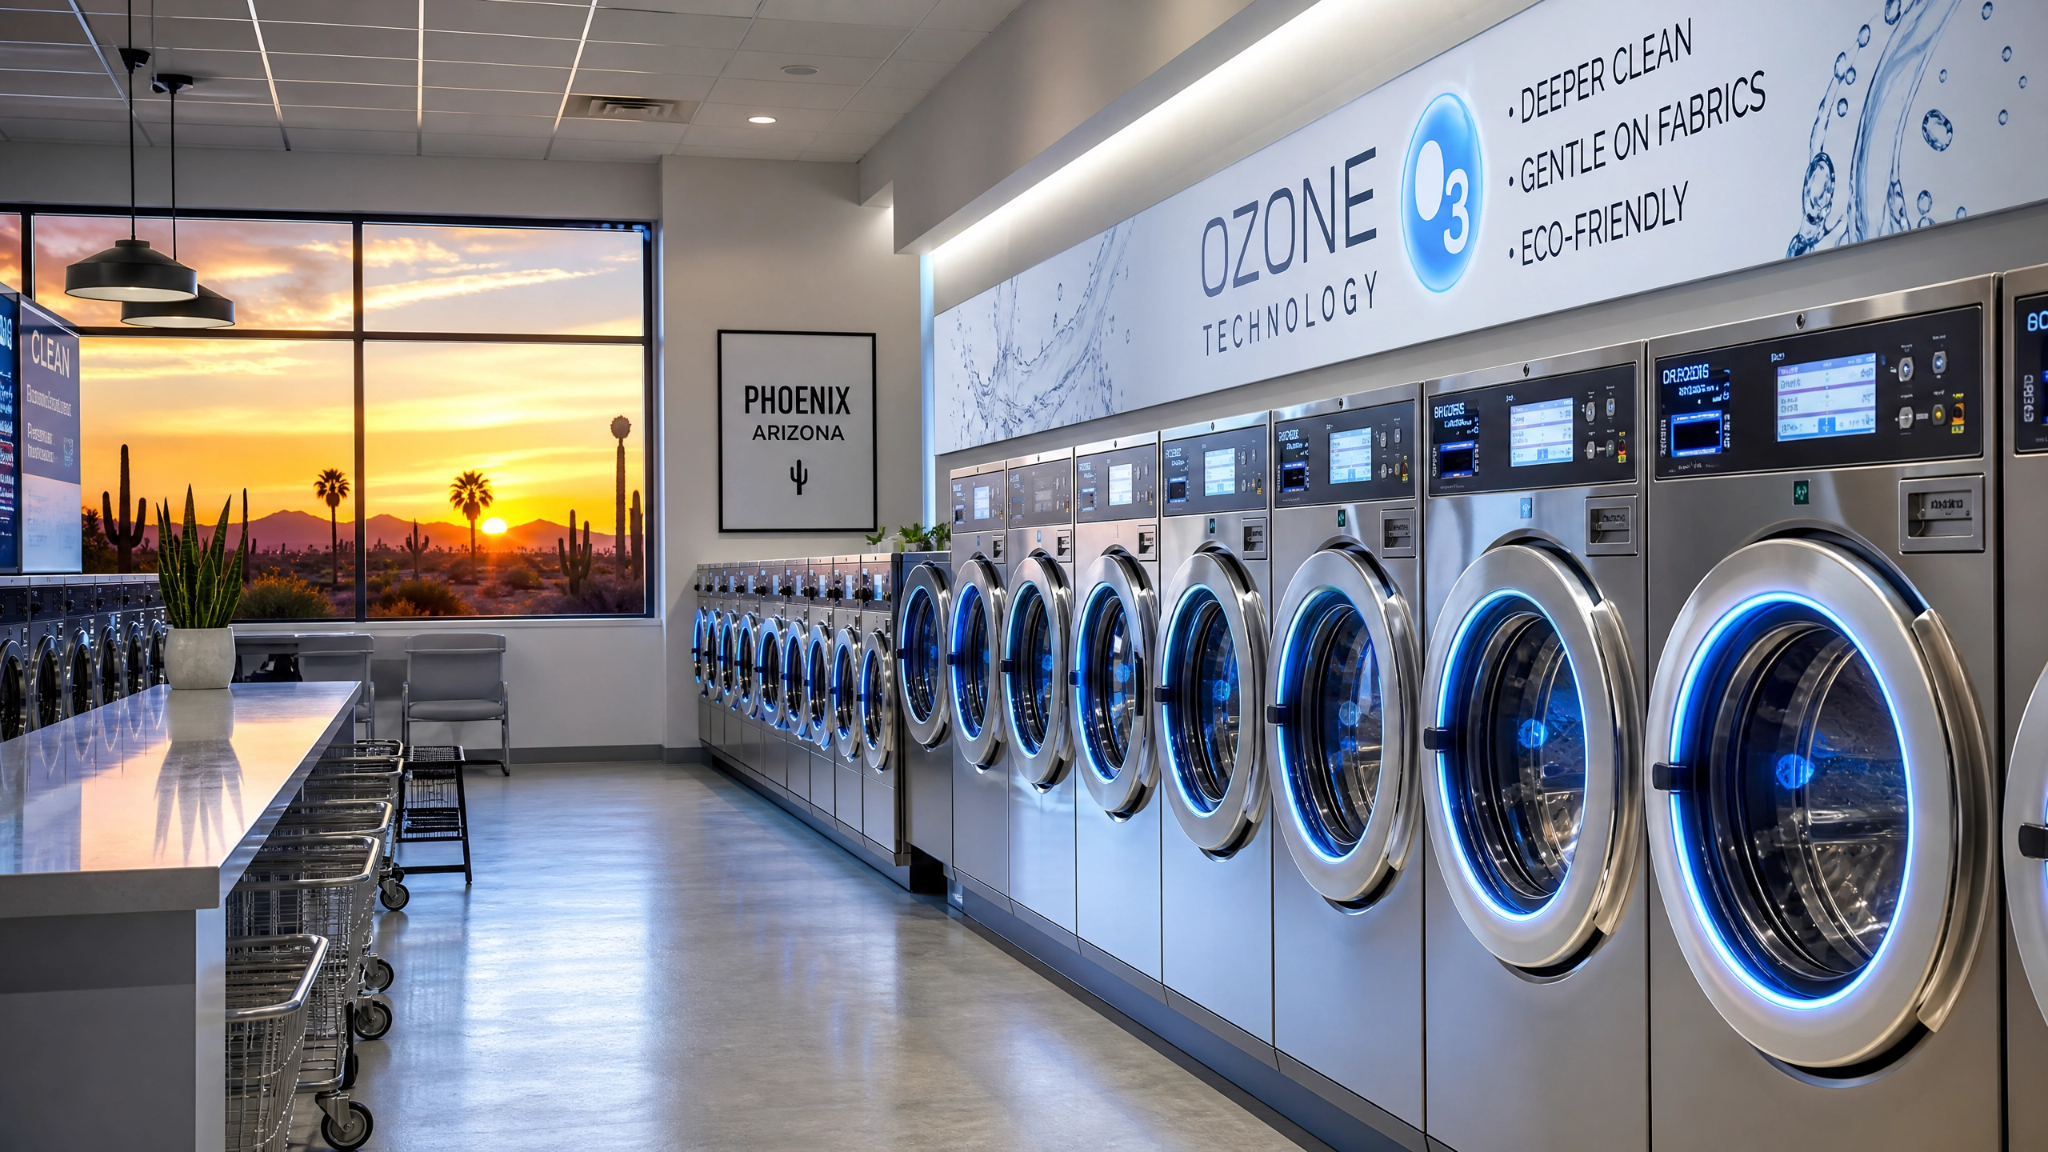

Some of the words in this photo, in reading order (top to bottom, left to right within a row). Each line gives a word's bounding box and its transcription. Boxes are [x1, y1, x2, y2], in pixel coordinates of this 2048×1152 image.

[1521, 56, 1605, 124] DEEPER
[1613, 17, 1692, 85] CLEAN
[1521, 130, 1606, 193] GENTLE
[1614, 114, 1649, 161] ON
[1658, 70, 1766, 146] FABRICS
[1201, 146, 1377, 298] OZONE
[1522, 180, 1689, 266] ECO-FRIENDLY
[31, 329, 70, 379] CLEAN
[1203, 270, 1378, 356] TECHNOLOGY
[744, 385, 851, 415] PHOENIX
[752, 424, 845, 441] ARIZONA
